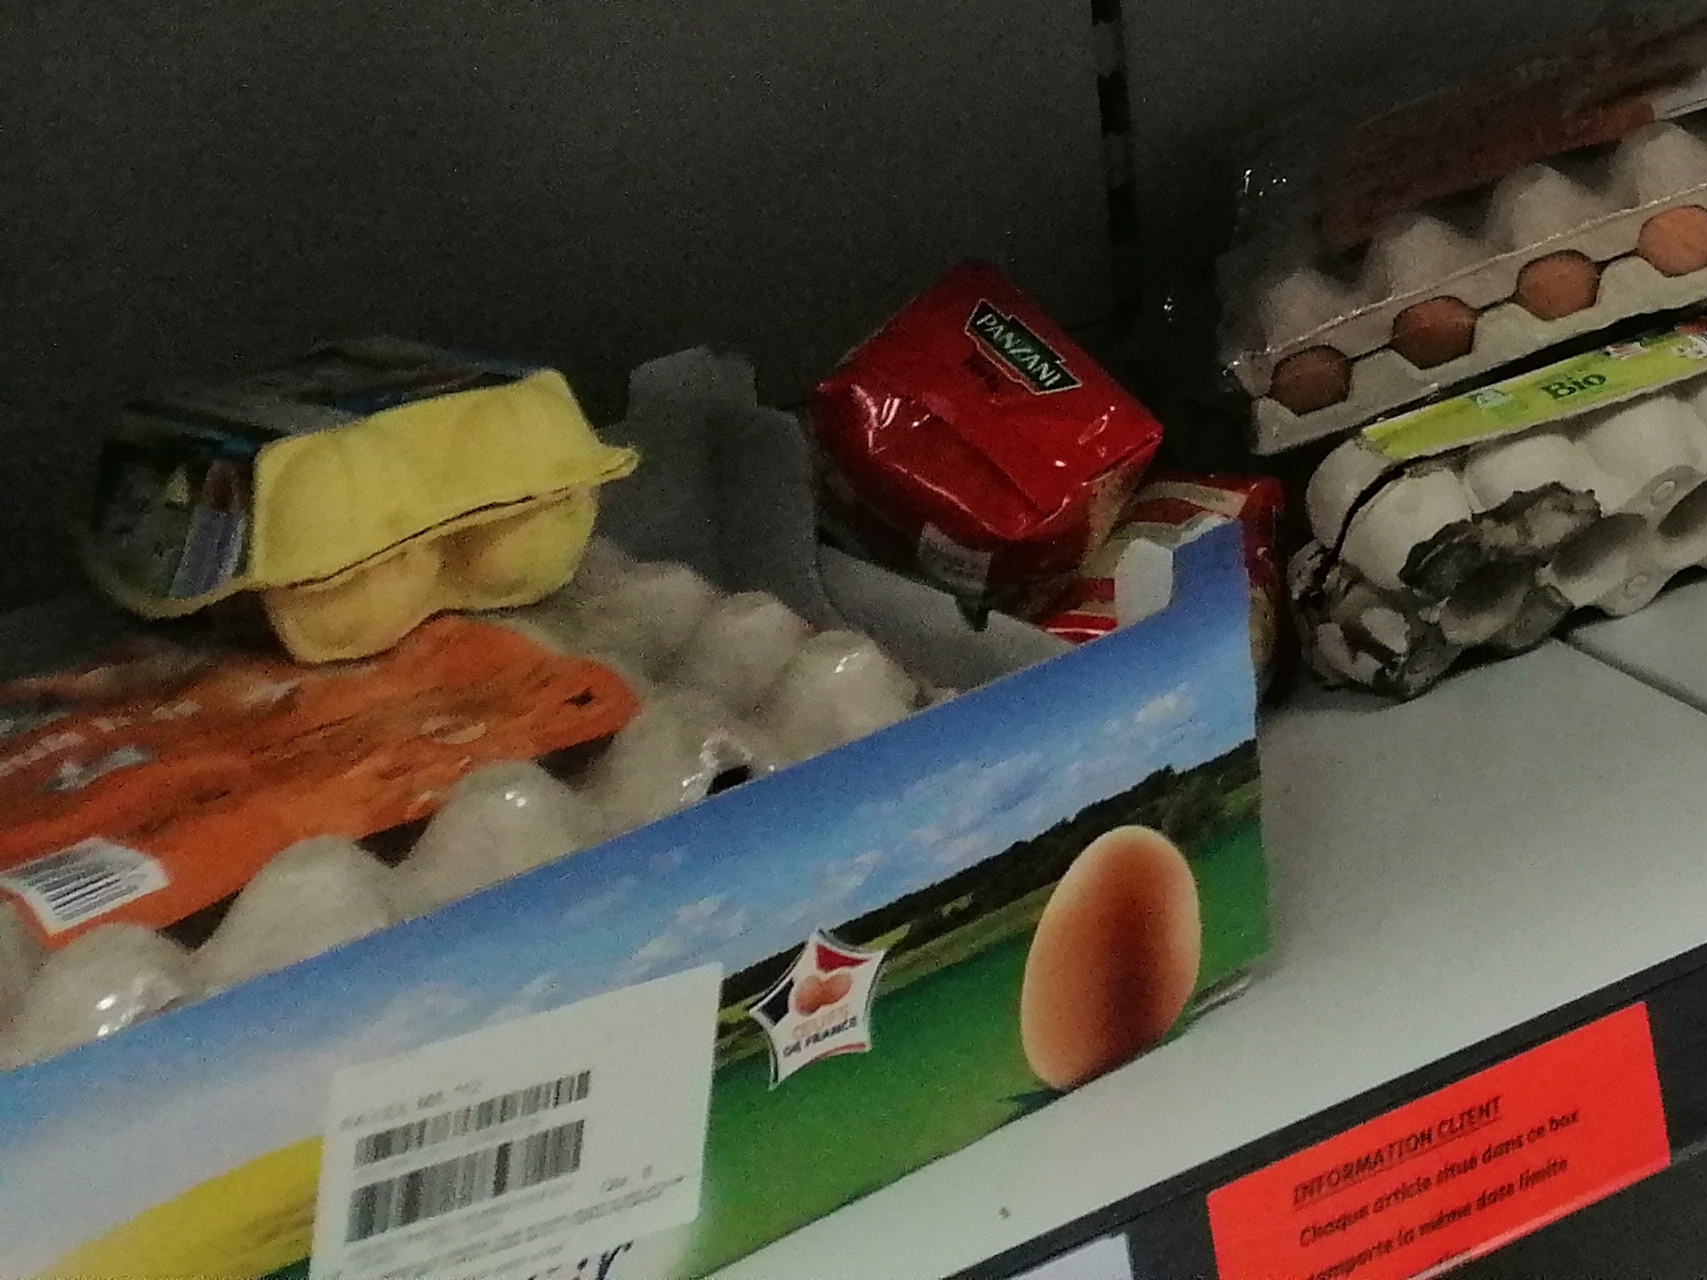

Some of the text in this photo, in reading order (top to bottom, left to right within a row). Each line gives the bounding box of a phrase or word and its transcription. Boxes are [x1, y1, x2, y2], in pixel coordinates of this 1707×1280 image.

[976, 313, 1061, 388] PANZANI
[1540, 368, 1607, 403] Bio
[1293, 1095, 1500, 1206] INFORMATION CLIENT
[1300, 1204, 1369, 1248] Chaque
[1374, 1176, 1432, 1215] article
[1482, 1133, 1523, 1164] dans
[1548, 1109, 1579, 1132] box
[1477, 1182, 1515, 1211] date
[1518, 1158, 1568, 1191] limite
